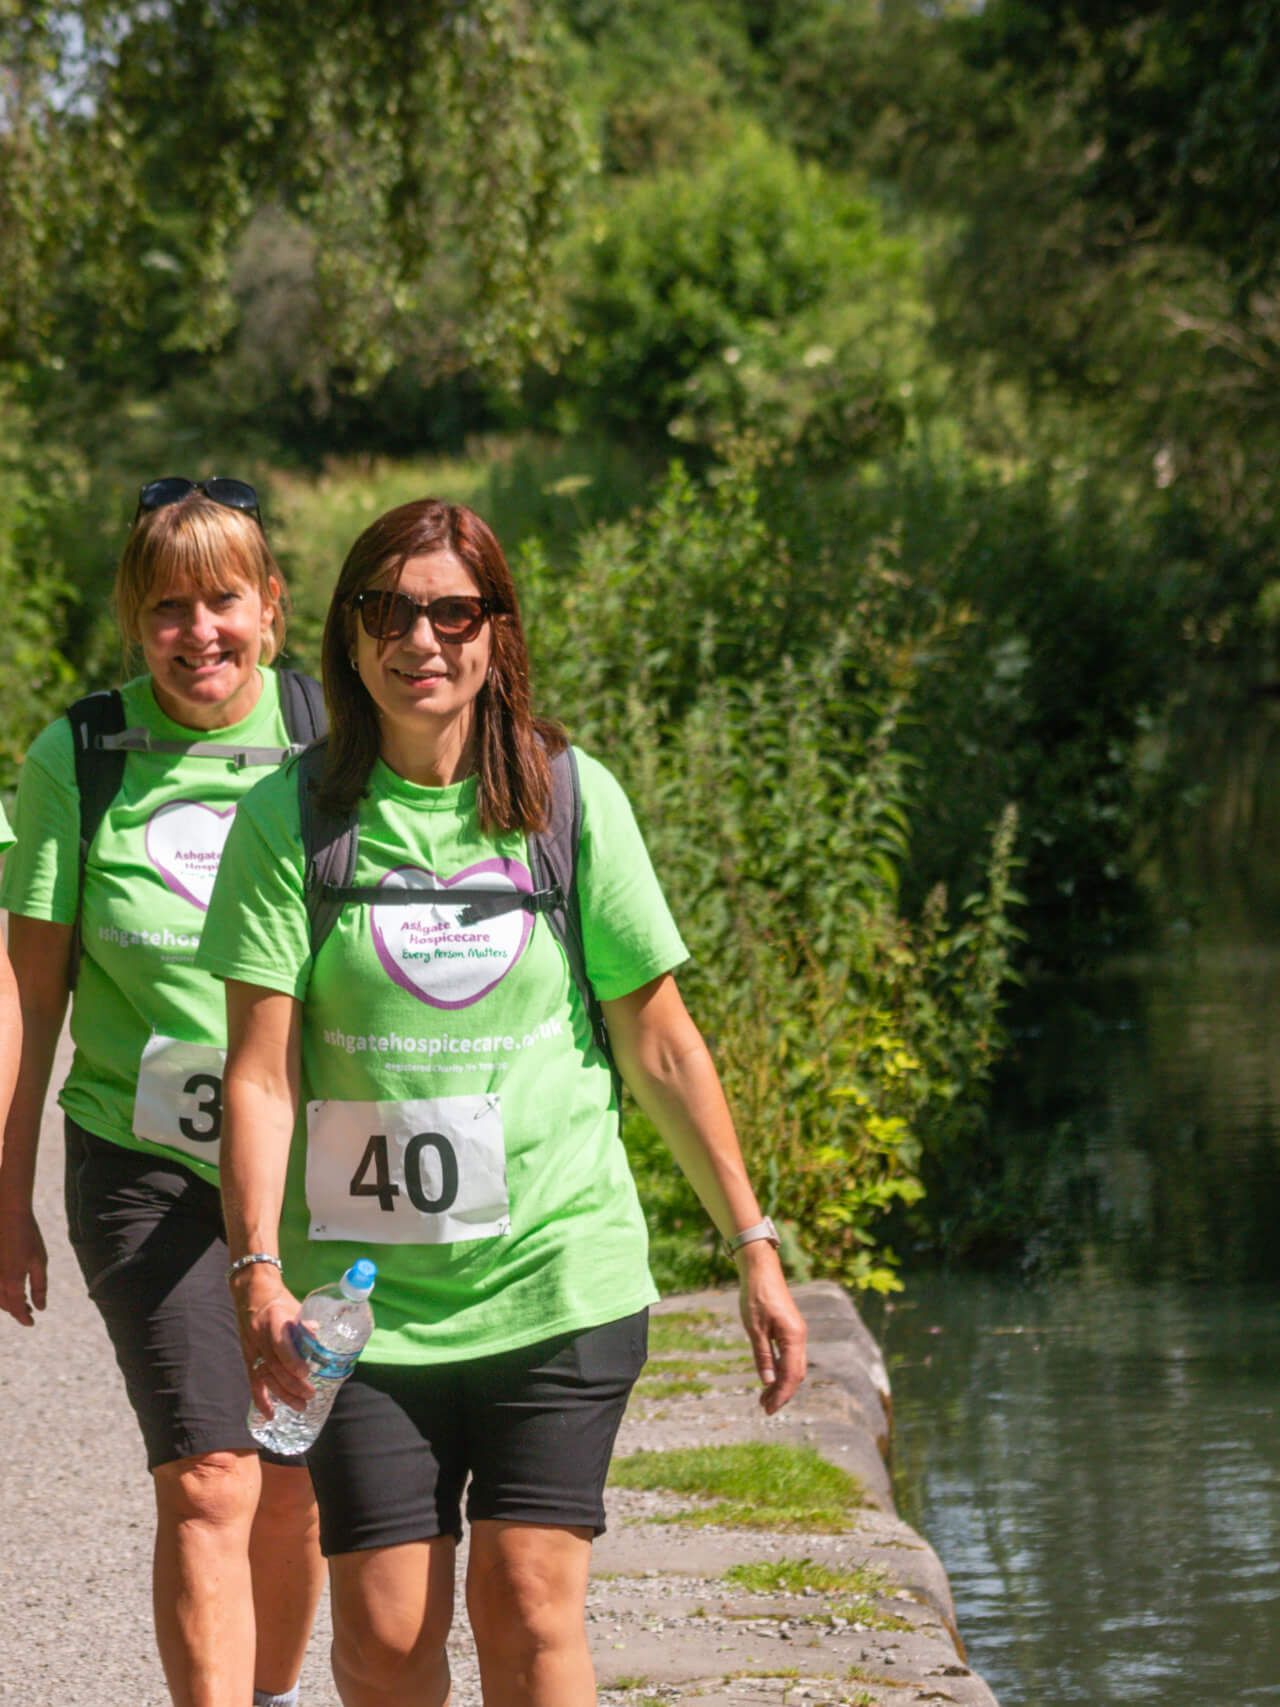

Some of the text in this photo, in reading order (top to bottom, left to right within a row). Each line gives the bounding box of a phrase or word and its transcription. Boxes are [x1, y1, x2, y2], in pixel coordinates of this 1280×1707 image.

[409, 932, 490, 946] Hospicecare
[402, 947, 508, 963] Every Person Matters
[349, 1132, 458, 1214] 40
